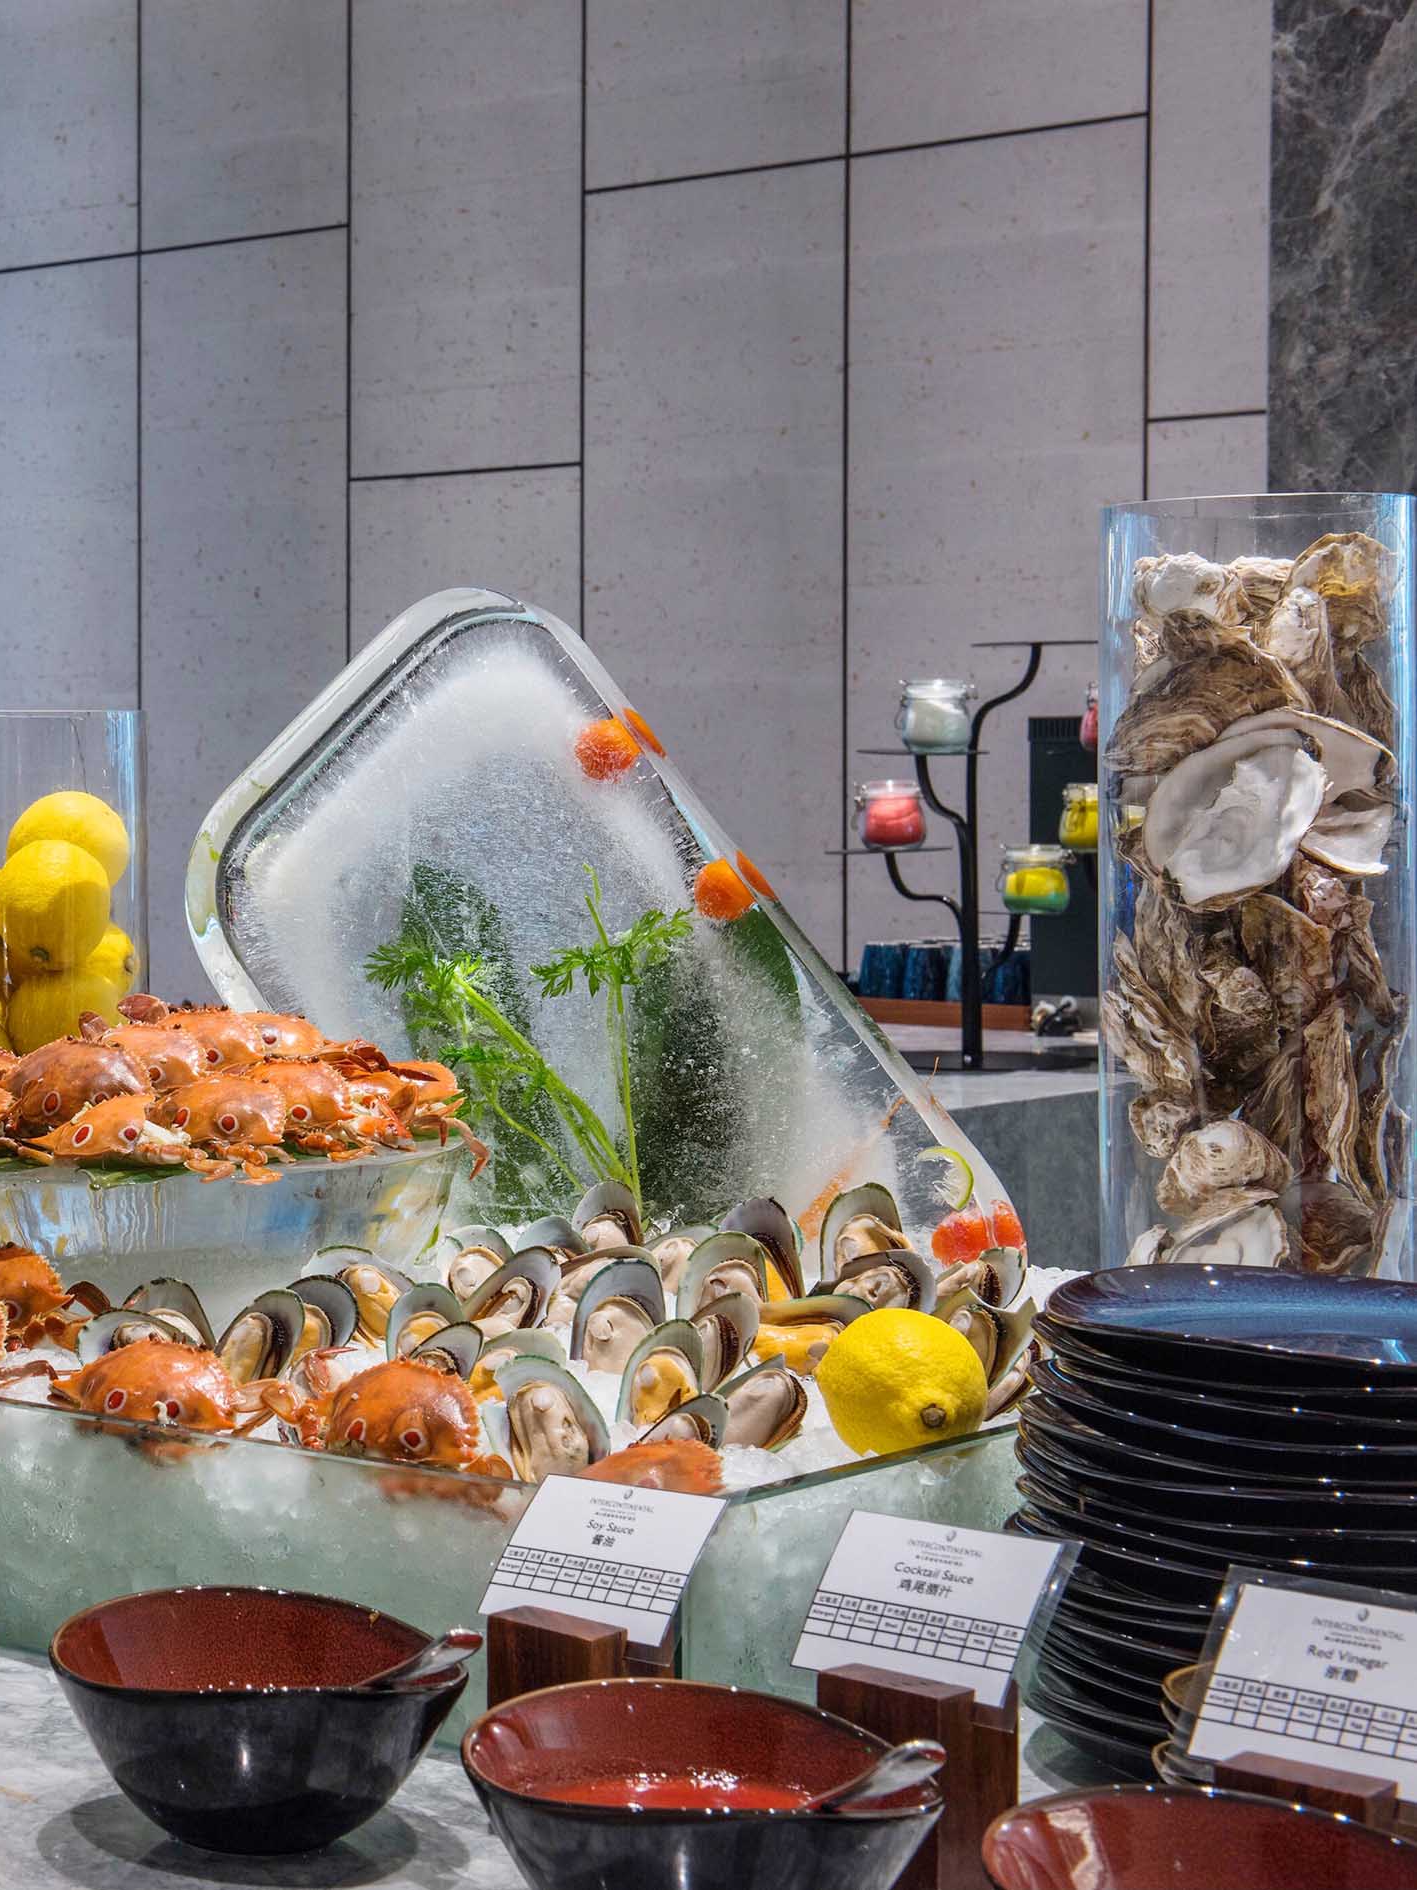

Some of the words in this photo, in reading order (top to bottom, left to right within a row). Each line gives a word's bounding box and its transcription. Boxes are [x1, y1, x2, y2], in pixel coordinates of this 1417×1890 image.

[586, 1519, 605, 1531] Soy
[606, 1522, 635, 1535] Sauce
[894, 1561, 940, 1578] Cocktail
[942, 1570, 974, 1584] Sauce
[1307, 1644, 1334, 1659] Red
[1338, 1650, 1389, 1670] Vinegar
